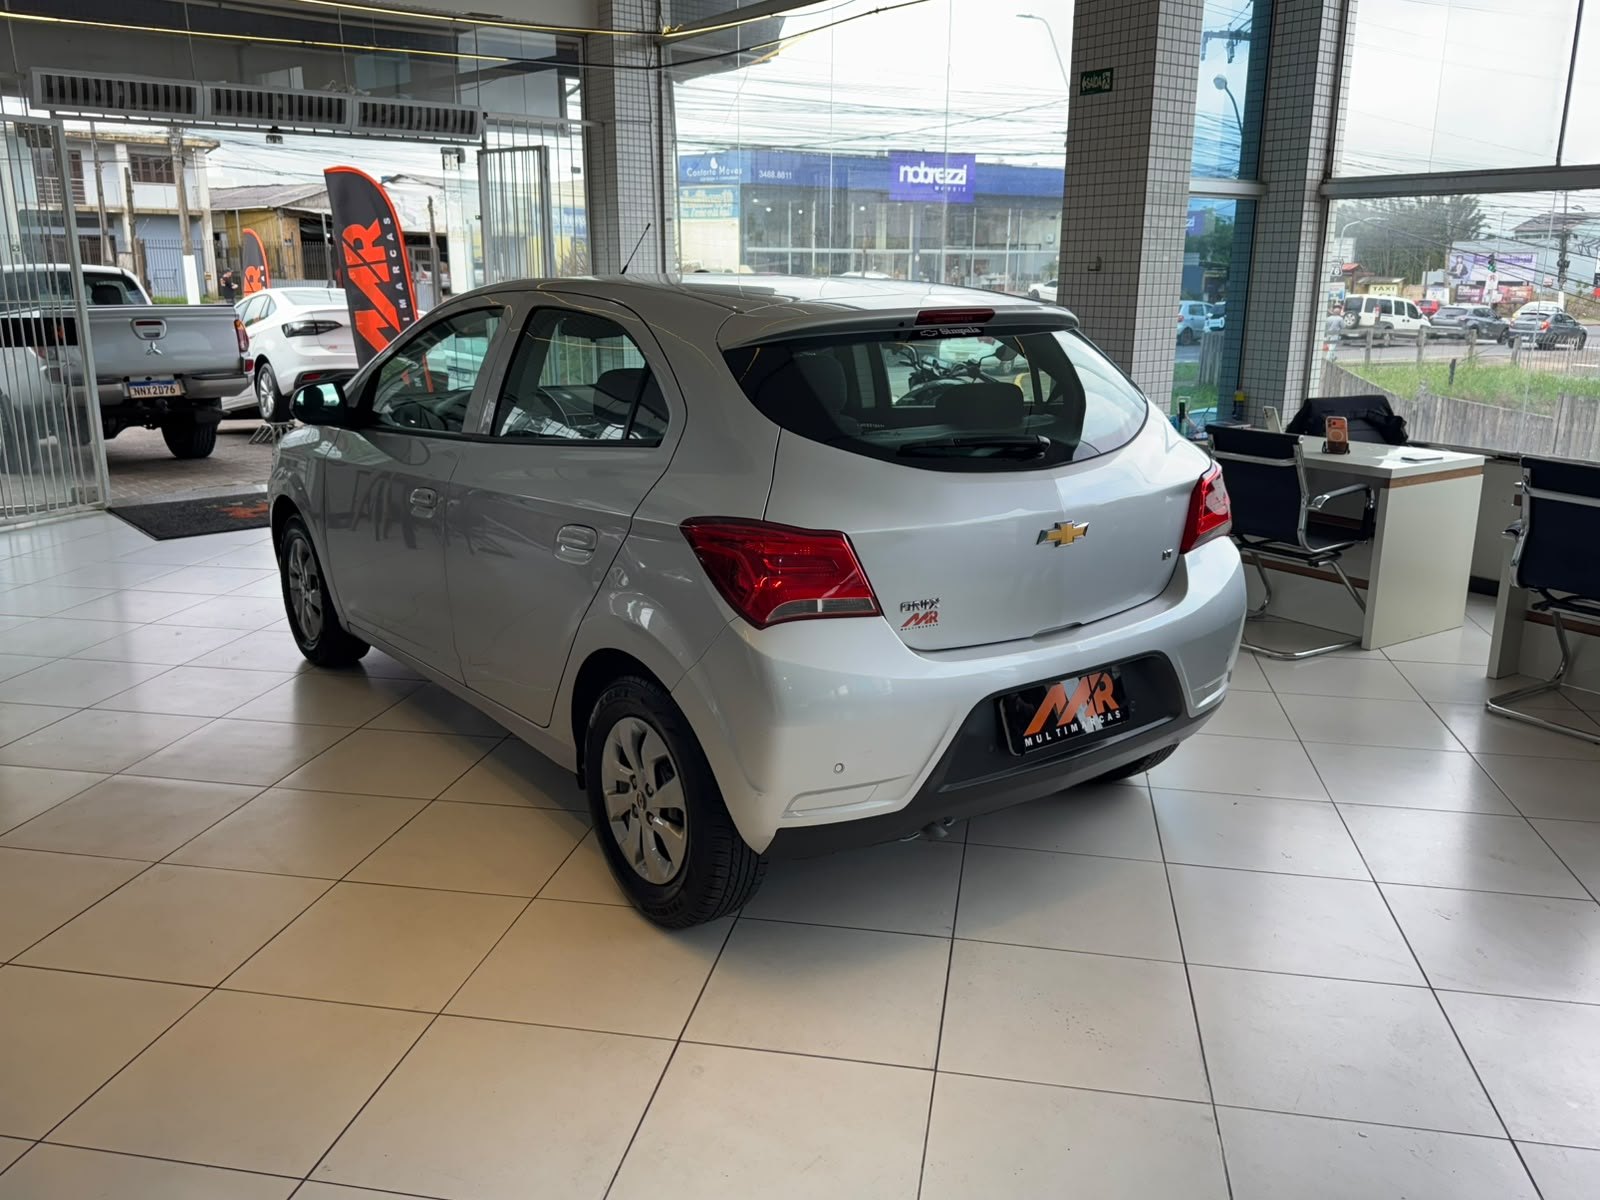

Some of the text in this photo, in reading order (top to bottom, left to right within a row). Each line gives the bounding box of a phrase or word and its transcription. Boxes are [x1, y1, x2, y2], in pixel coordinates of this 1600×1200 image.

[899, 161, 967, 185] nobrezzi
[133, 385, 176, 397] NNX2D76
[1024, 709, 1122, 748] MULTIMARCAS
